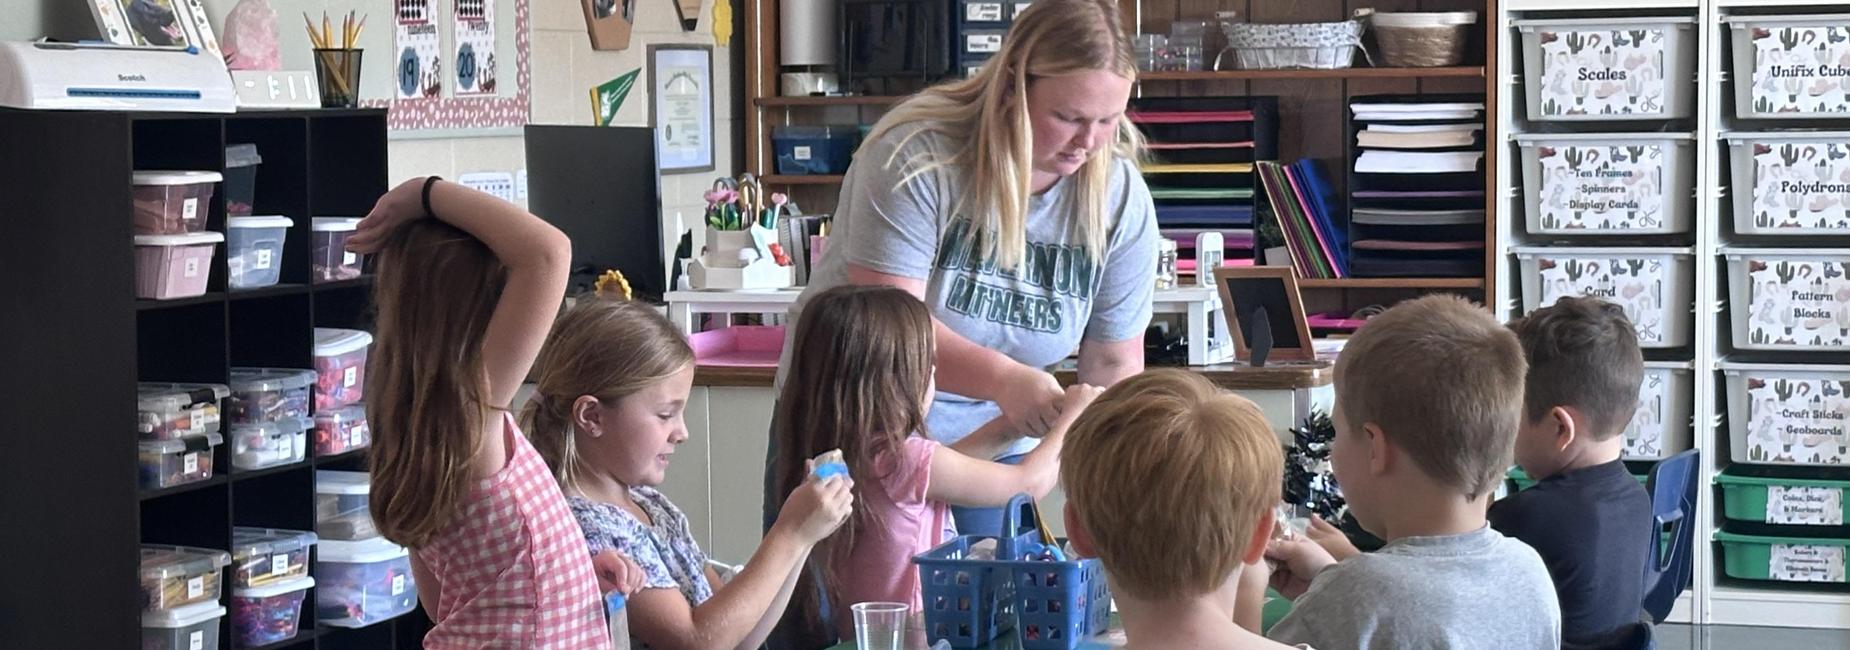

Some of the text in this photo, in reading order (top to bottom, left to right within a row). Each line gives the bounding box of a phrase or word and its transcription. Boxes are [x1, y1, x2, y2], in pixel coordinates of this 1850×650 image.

[459, 52, 474, 78] 20
[1771, 64, 1814, 77] Unifix
[118, 74, 146, 82] Scotch
[403, 58, 415, 87] 19
[1577, 66, 1627, 81] Scales
[1595, 167, 1633, 178] Frames
[1608, 200, 1639, 209] Cards
[1585, 285, 1616, 297] Card
[1792, 290, 1833, 301] Pattern
[1794, 307, 1831, 318] Blocks
[1813, 409, 1843, 420] Sticks
[1786, 424, 1842, 435] Geoboards
